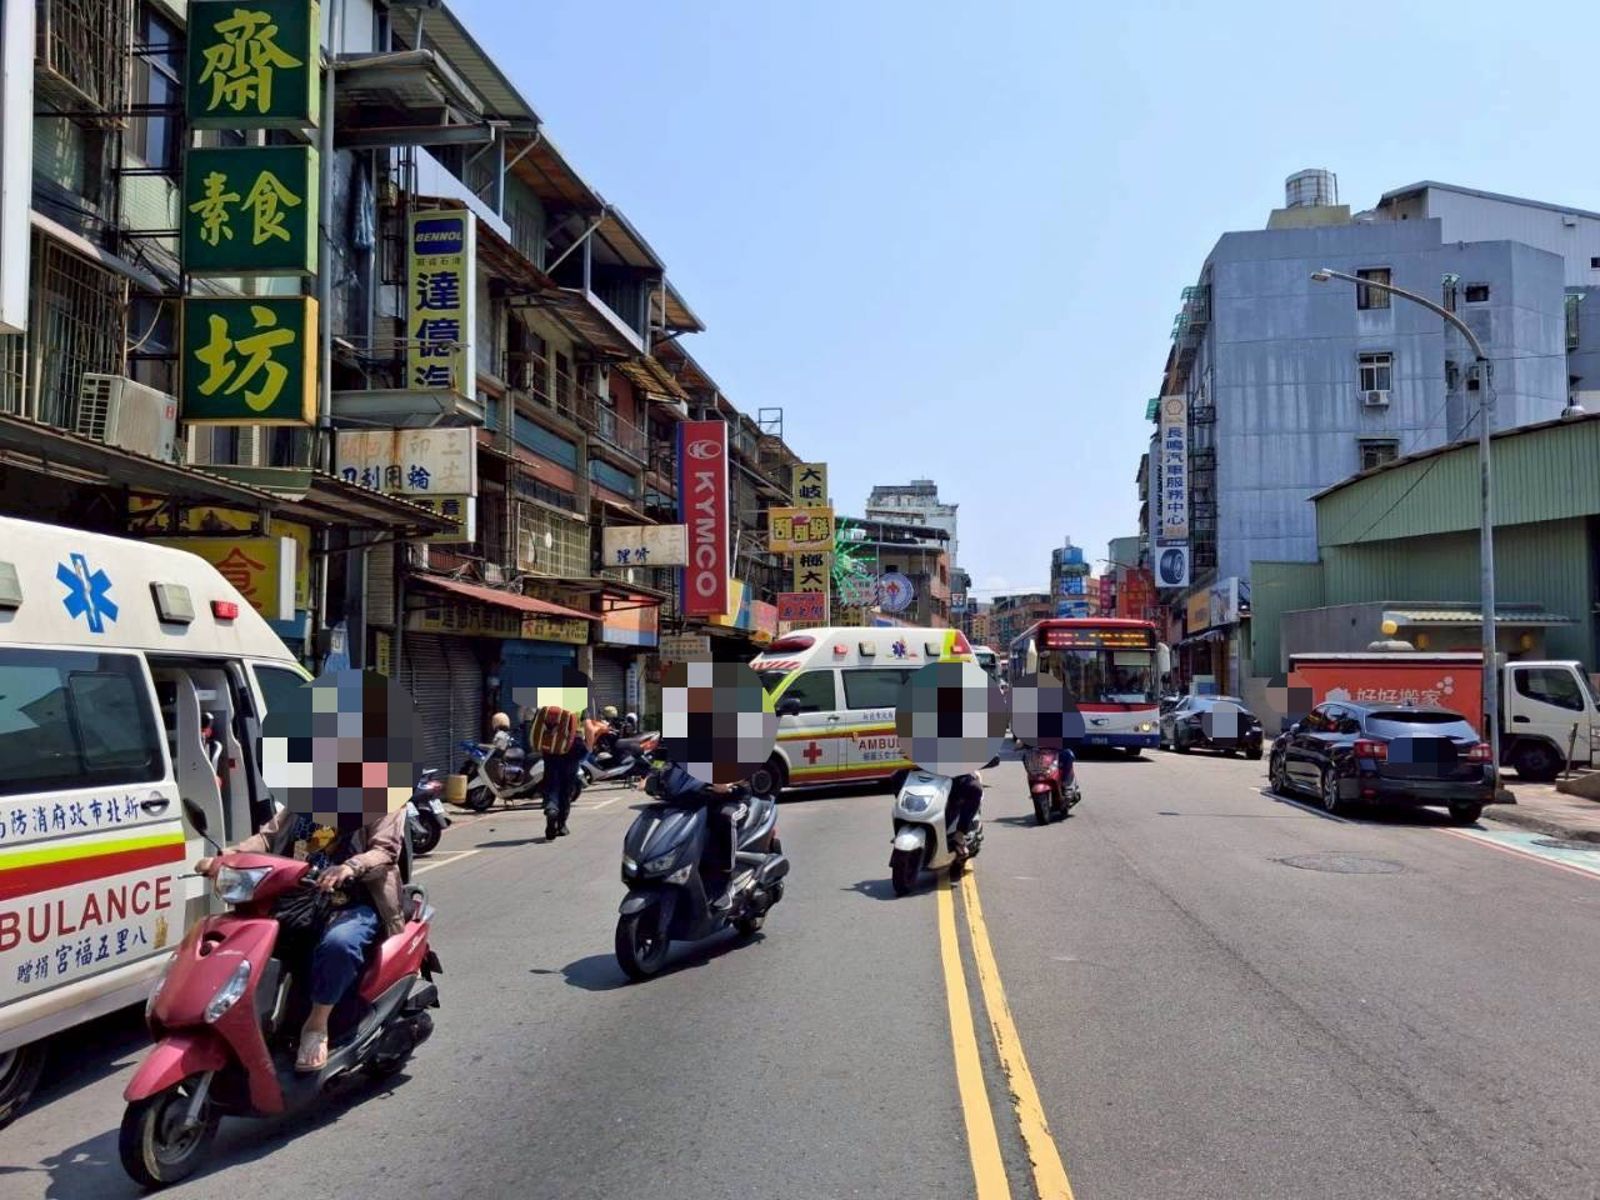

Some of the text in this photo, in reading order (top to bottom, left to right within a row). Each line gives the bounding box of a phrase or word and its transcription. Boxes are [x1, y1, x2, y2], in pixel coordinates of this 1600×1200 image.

[199, 9, 302, 114] 齋
[189, 170, 301, 247] 素食
[194, 305, 295, 411] 坊
[1166, 427, 1184, 525] 長鳴汽車服務中心
[694, 472, 717, 597] KYMCO
[1358, 687, 1440, 706] 好好搬家
